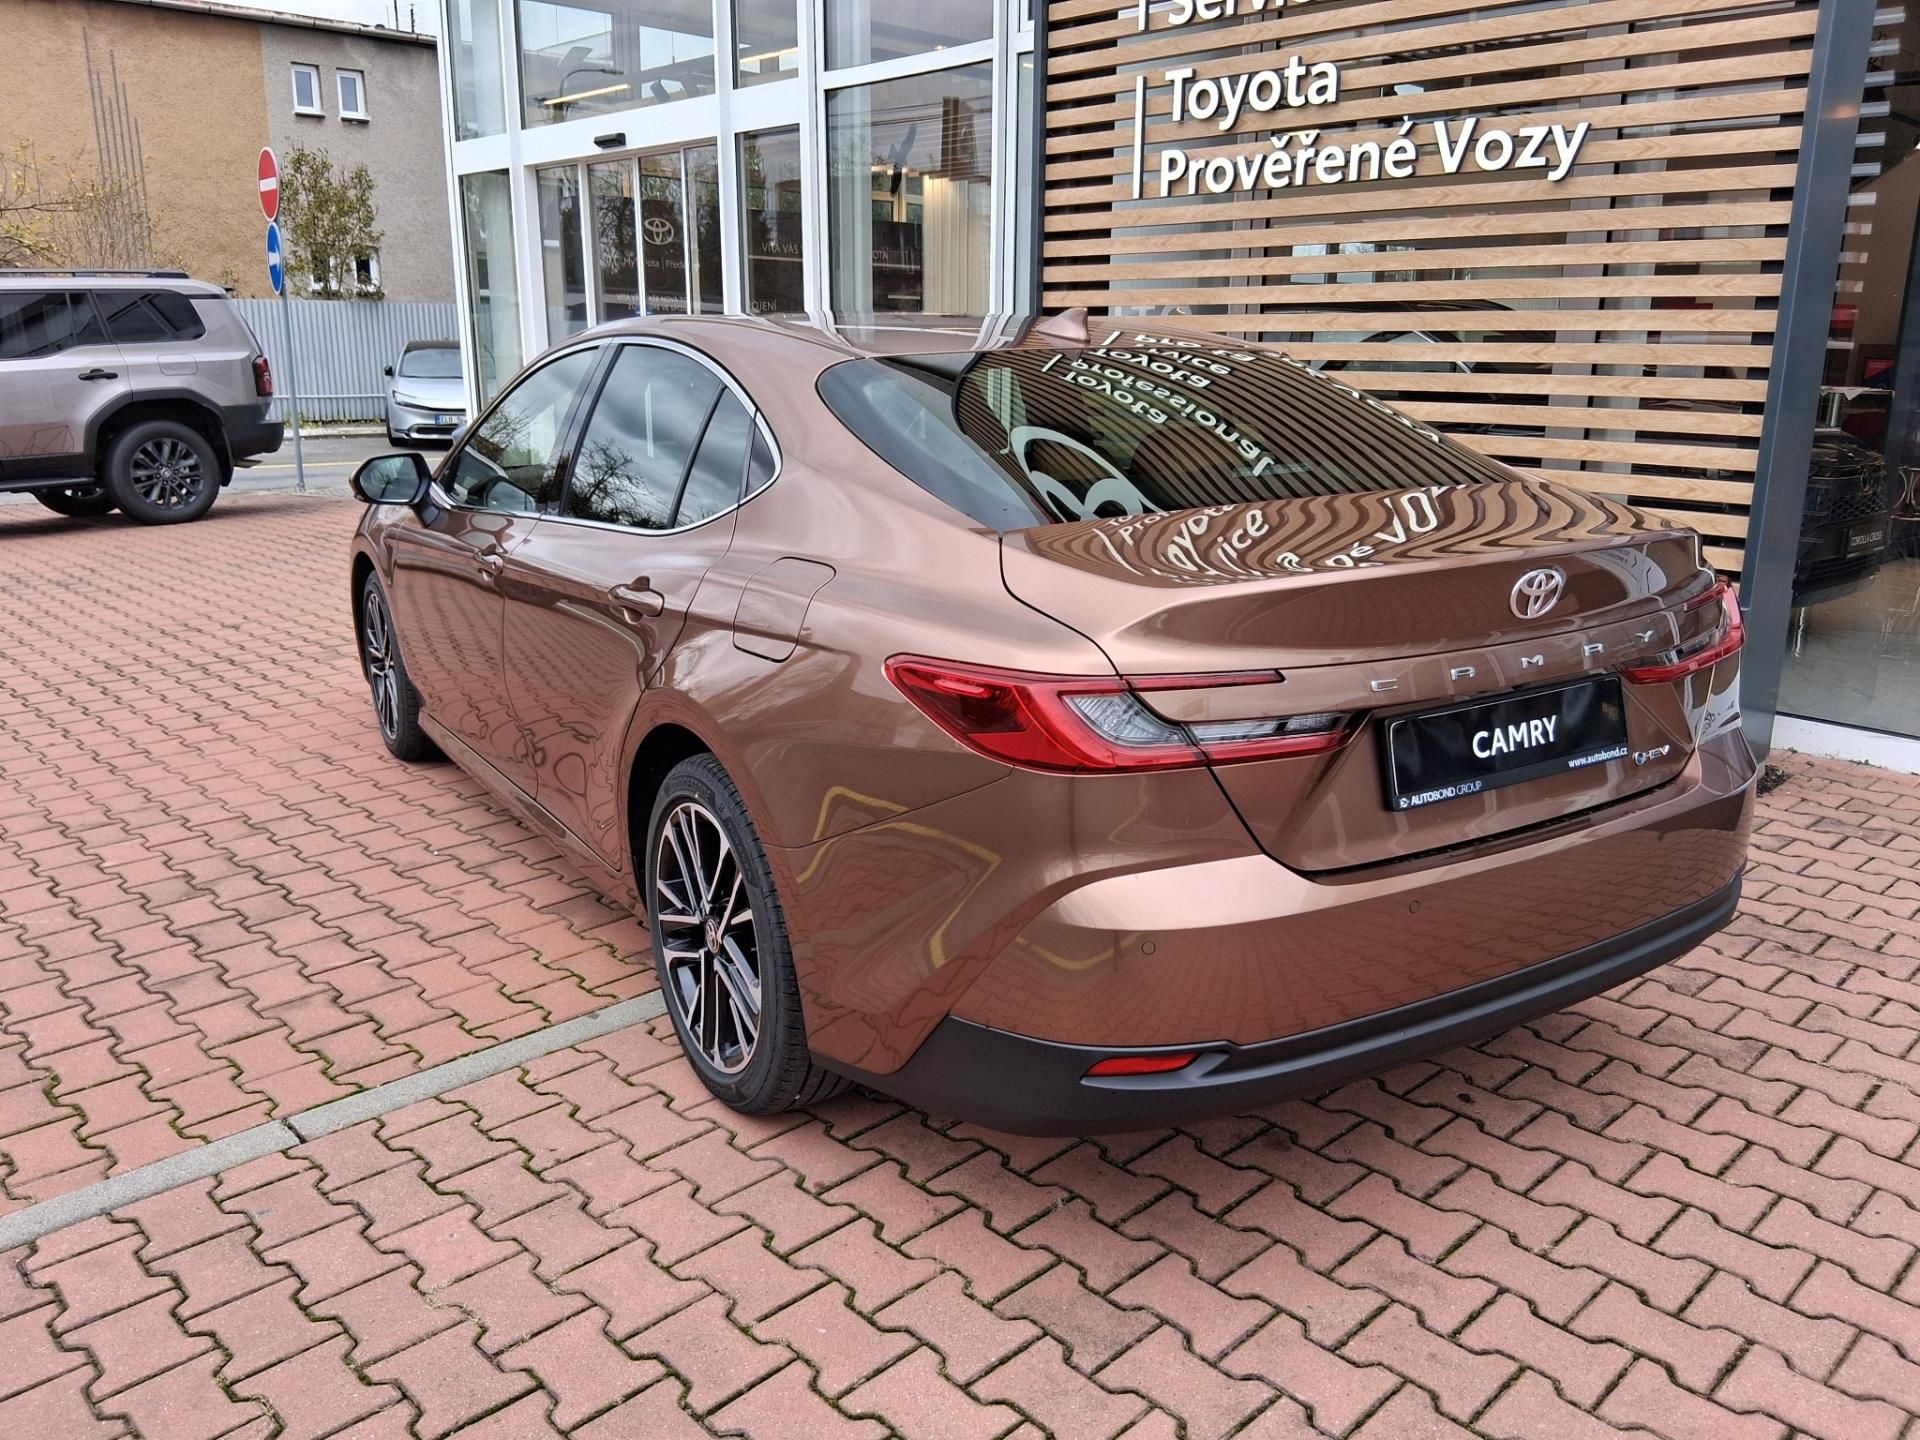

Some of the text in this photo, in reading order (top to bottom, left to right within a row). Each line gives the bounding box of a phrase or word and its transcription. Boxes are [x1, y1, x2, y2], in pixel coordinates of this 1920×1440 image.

[1164, 55, 1339, 132] Toyota
[1160, 115, 1591, 198] Prověřené Vozy
[1369, 629, 1655, 692] CAMRY
[1472, 714, 1558, 760] CAMRY
[1567, 746, 1628, 769] www.autobond.cz
[1410, 780, 1482, 806] AUTOBOND GROUP
